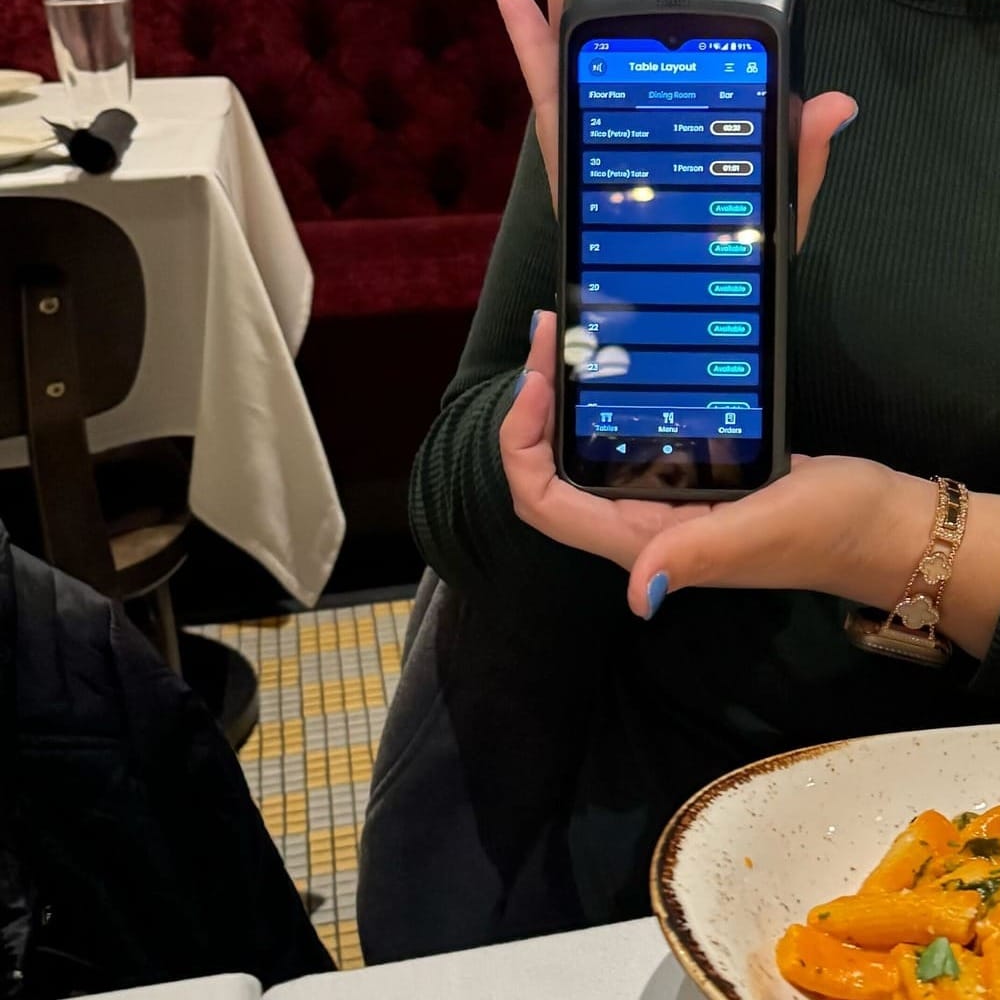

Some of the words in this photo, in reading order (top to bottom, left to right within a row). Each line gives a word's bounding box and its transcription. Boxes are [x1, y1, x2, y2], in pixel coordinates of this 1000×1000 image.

[628, 62, 659, 71] Table
[660, 62, 697, 74] Layout
[588, 91, 608, 99] Floor
[608, 91, 626, 99] Plan
[648, 91, 673, 100] Dining
[673, 91, 697, 99] Room
[719, 91, 734, 99] Bar
[678, 124, 704, 132] Person
[677, 164, 704, 172] Person
[594, 424, 618, 432] Tables
[657, 425, 679, 433] Menu
[718, 426, 743, 434] Orders
